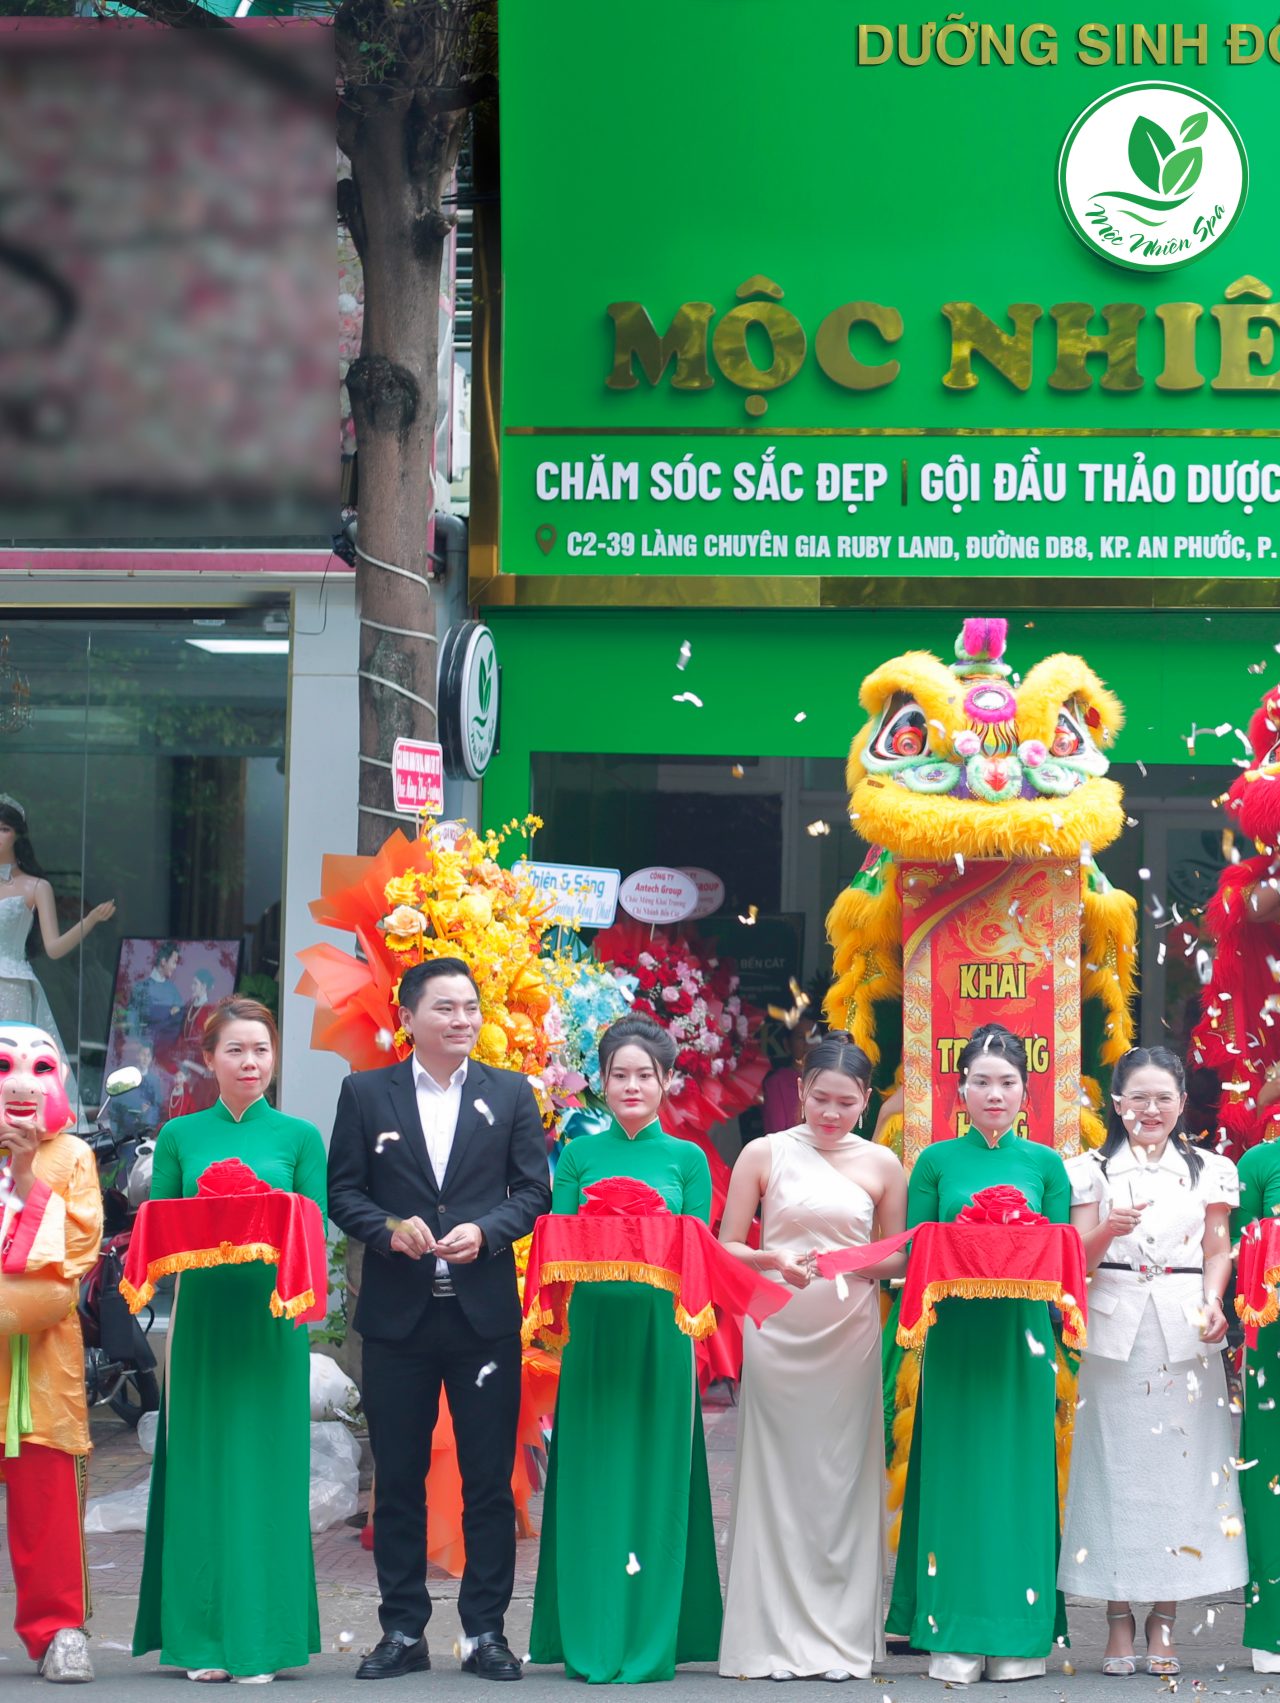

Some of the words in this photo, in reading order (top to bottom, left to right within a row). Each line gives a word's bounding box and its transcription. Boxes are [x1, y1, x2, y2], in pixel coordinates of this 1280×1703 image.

[857, 13, 1059, 66] DƯỠNG
[1076, 22, 1208, 66] SINH
[1085, 203, 1124, 246] Mộc
[1129, 233, 1192, 257] Nhiên
[1193, 204, 1226, 243] Spa
[605, 274, 905, 417] MỘC
[536, 453, 639, 500] CHĂM
[650, 453, 721, 501] SÓC
[733, 446, 804, 501] SẮC
[816, 463, 888, 514] ĐẸP
[920, 454, 980, 514] GỘI
[993, 447, 1066, 502] ĐẦU
[1078, 451, 1176, 503] THẢO
[567, 531, 635, 557] C2-39
[641, 529, 697, 557] LÀNG
[704, 530, 788, 557] CHUYÊN
[795, 535, 831, 558] GIA
[837, 536, 892, 558] RUBY
[898, 536, 959, 561] LAND,
[966, 530, 1040, 559] ĐƯỜNG
[1046, 536, 1093, 561] DB8,
[1100, 536, 1132, 558] KP.
[1137, 536, 1168, 559] AN
[1174, 530, 1252, 561] PHƯỚC,
[635, 882, 659, 893] Antech
[660, 885, 683, 897] Group
[959, 963, 1027, 999] KHAI
